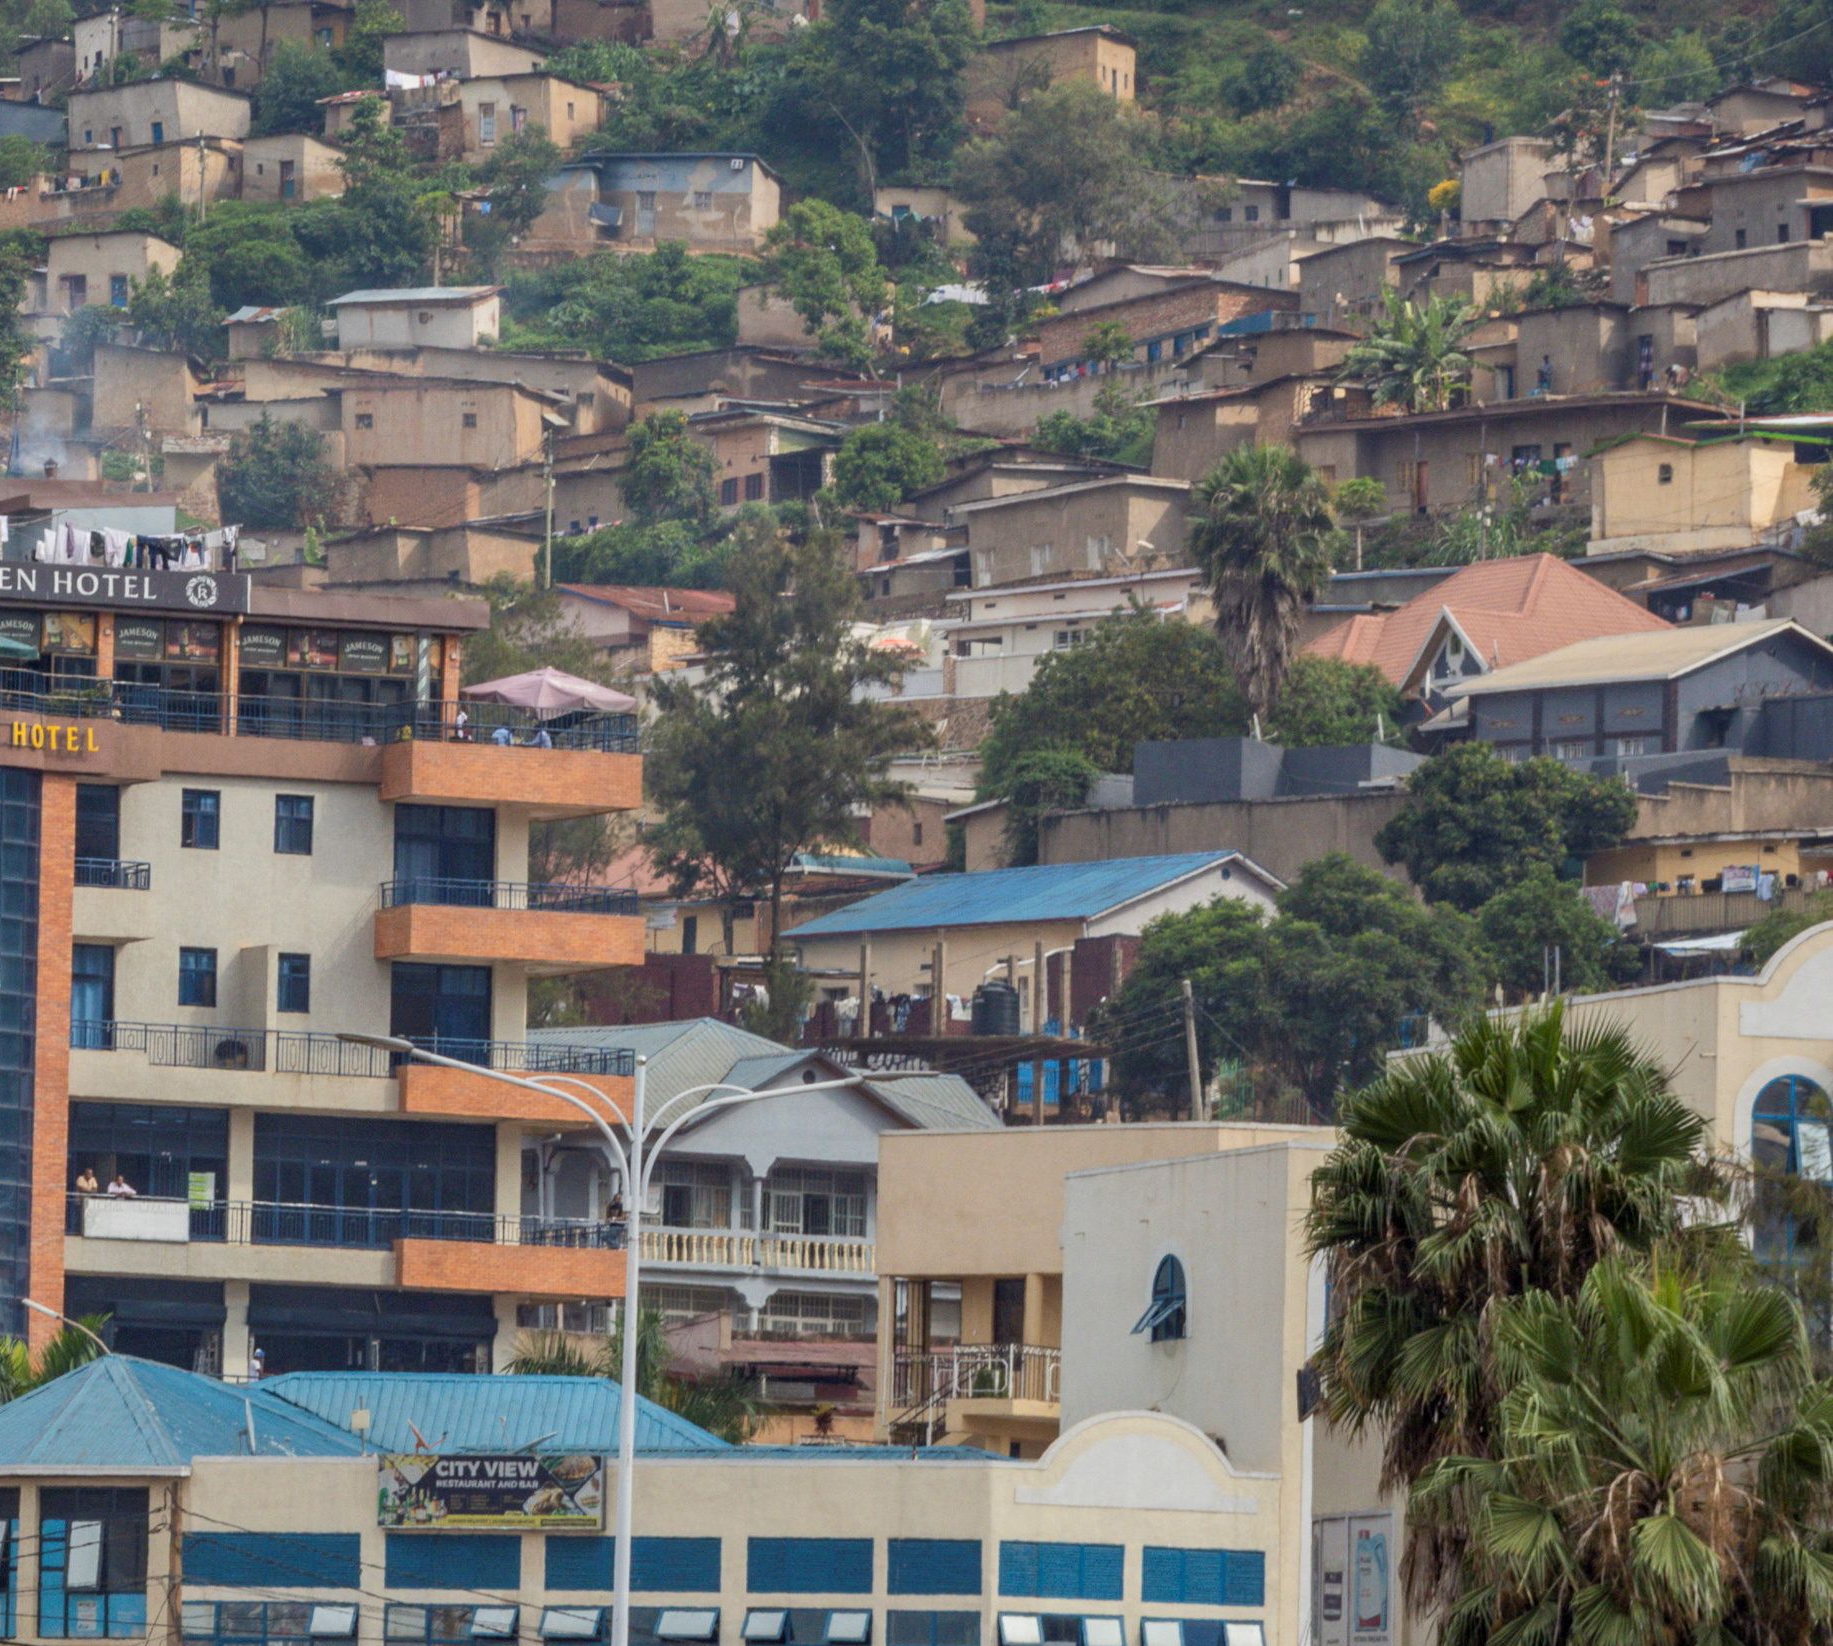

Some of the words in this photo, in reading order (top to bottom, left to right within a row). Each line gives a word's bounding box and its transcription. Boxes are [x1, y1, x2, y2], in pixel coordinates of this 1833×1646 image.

[53, 571, 157, 600] HOTEL
[119, 627, 158, 640] JAMESON
[242, 635, 282, 649] JAMESON
[345, 643, 384, 657] JAMESON
[12, 720, 100, 752] HOTEL
[436, 1459, 481, 1478] CITY
[484, 1459, 539, 1478] VIEW
[436, 1479, 495, 1489] RESTAURANT
[497, 1480, 517, 1489] AND
[518, 1480, 539, 1489] BAR
